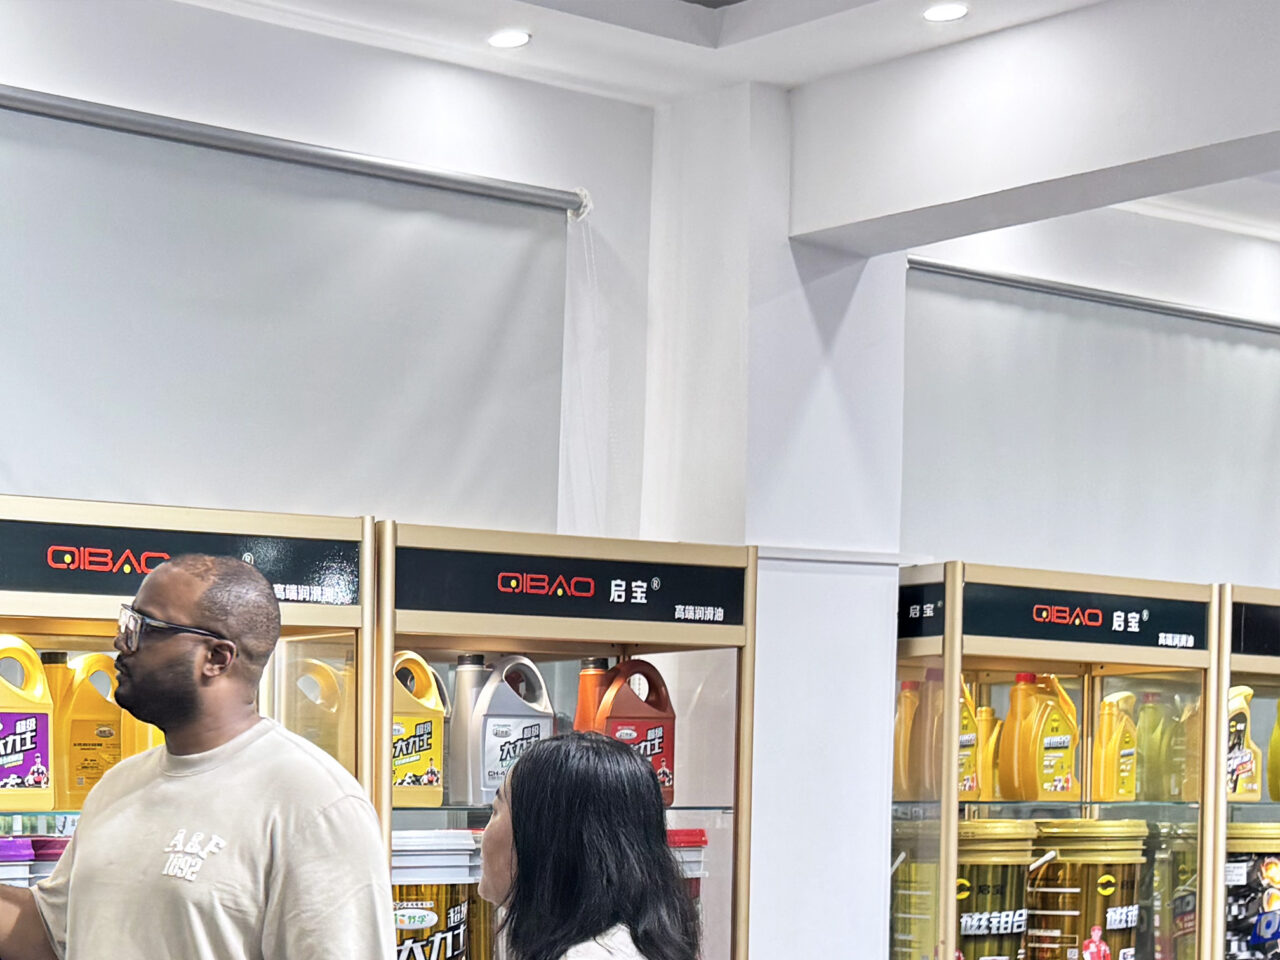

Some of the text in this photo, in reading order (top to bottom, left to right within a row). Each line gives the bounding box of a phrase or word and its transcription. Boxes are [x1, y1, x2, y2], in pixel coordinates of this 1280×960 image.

[497, 572, 595, 598] QIBAO
[674, 605, 724, 622] 高端润滑油
[1033, 604, 1103, 626] QIBAO
[1158, 633, 1195, 648] 高端润滑油
[393, 734, 432, 758] 大力士
[161, 854, 203, 881] 1892
